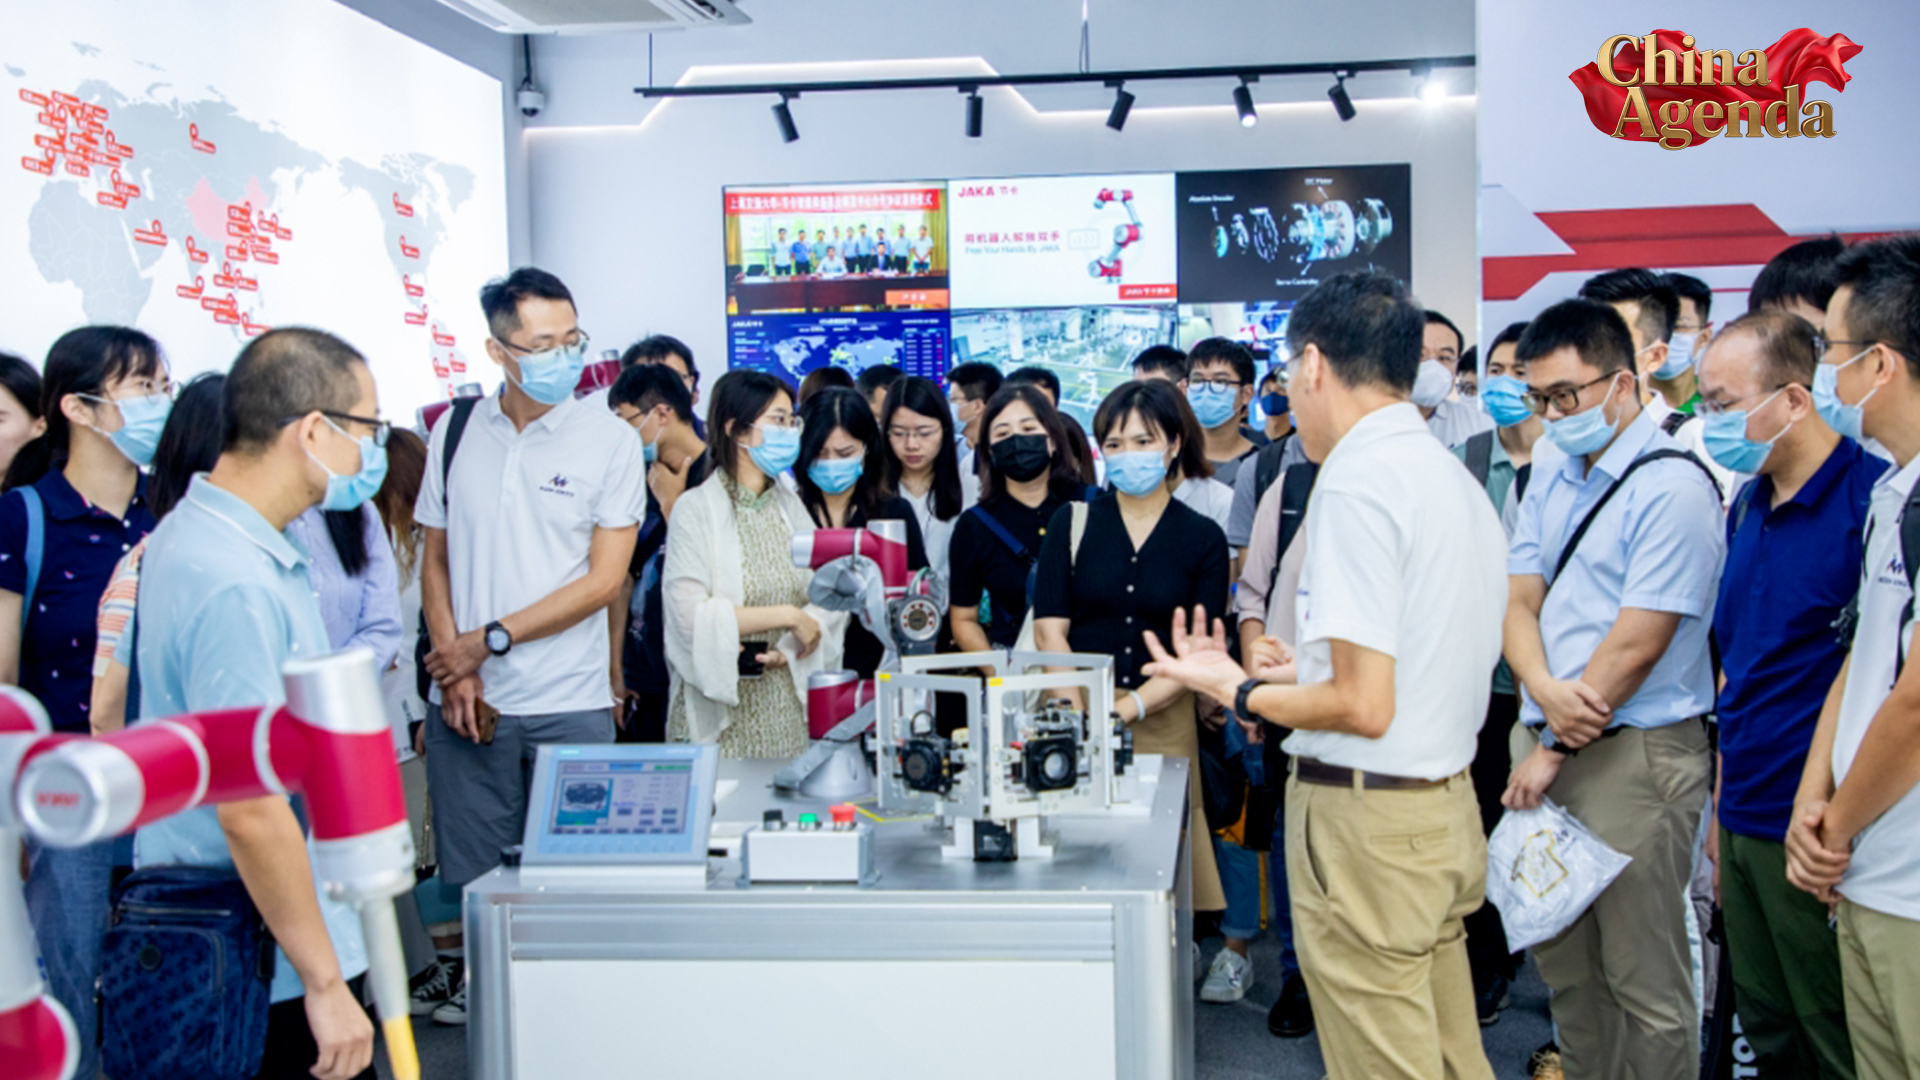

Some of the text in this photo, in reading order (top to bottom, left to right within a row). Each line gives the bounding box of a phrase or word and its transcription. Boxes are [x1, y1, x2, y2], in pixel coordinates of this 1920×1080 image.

[957, 184, 1019, 198] JAKA 节卡
[964, 230, 1060, 245] 用机器人解放双手
[965, 244, 1060, 255] Free Your Hands By JAKA
